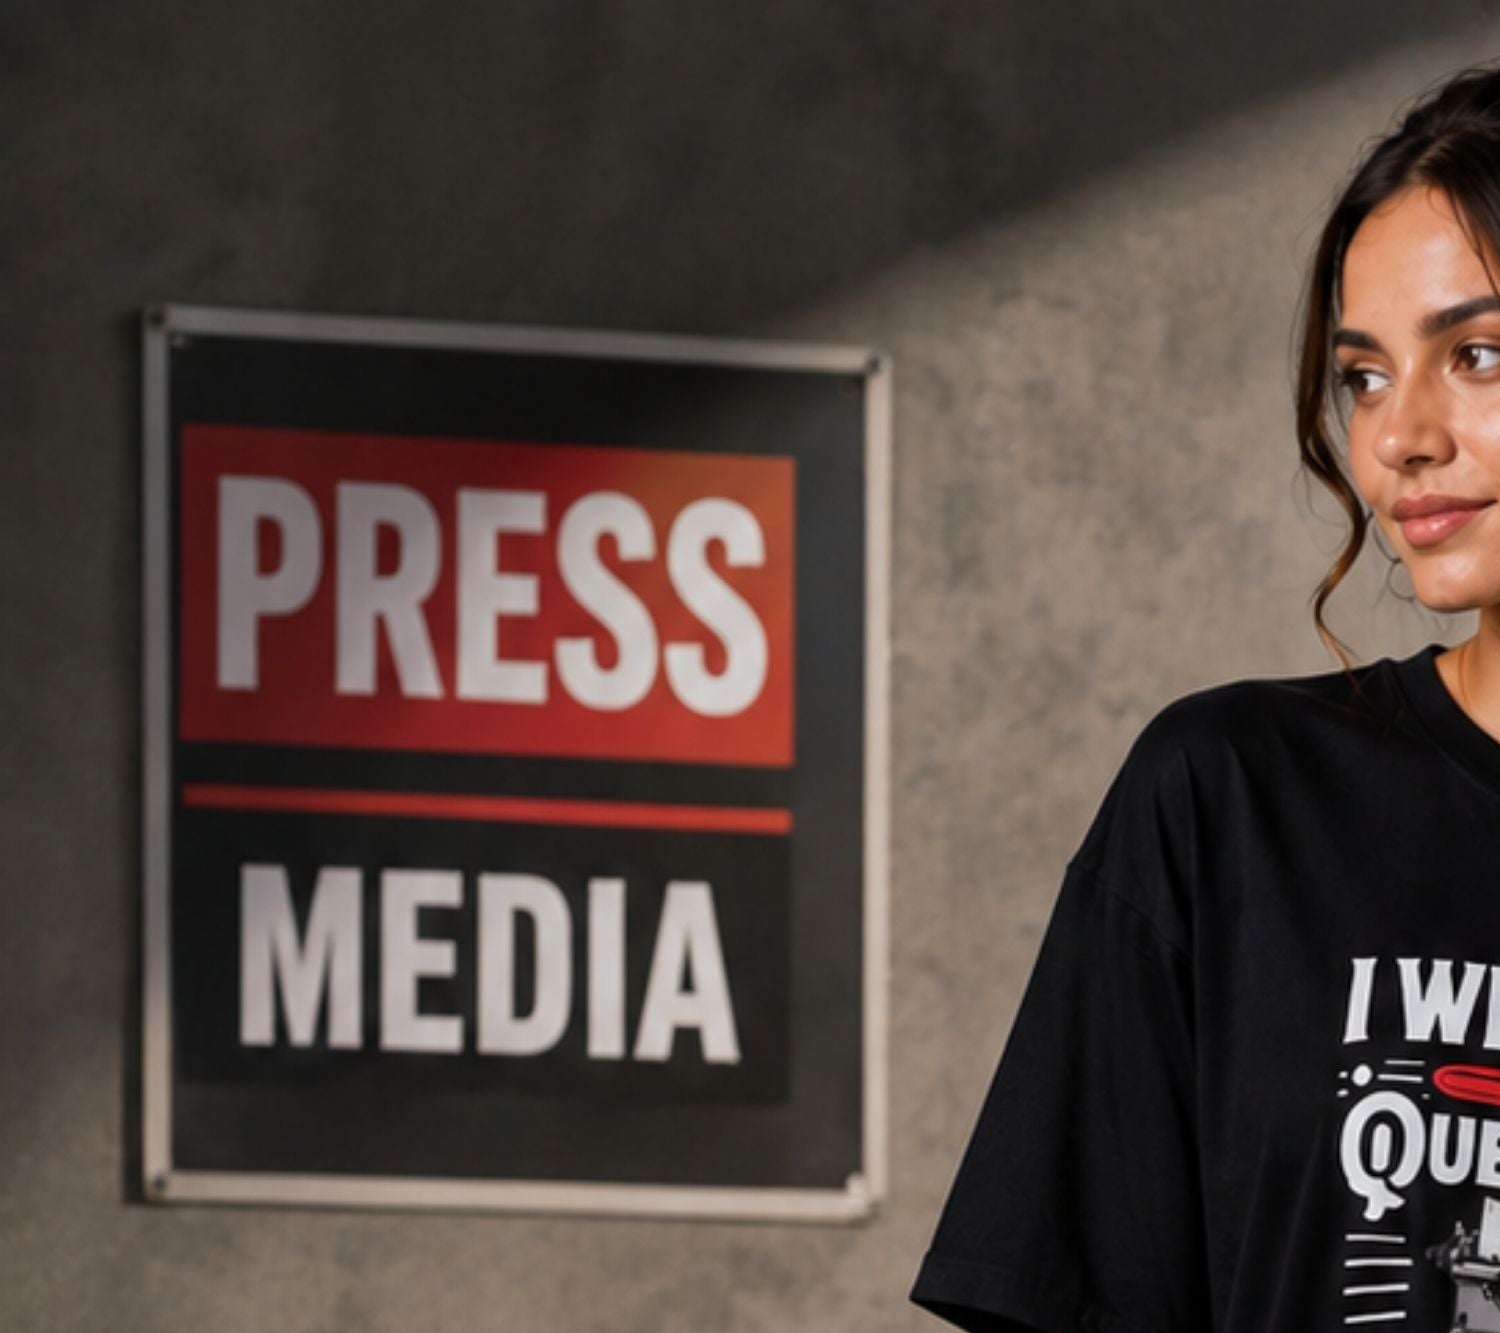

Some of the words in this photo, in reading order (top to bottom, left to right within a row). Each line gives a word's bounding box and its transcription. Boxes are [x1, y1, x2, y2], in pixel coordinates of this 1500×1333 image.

[219, 475, 769, 717] PRESS
[241, 864, 740, 1064] MEDIA
[1343, 957, 1377, 1044] I
